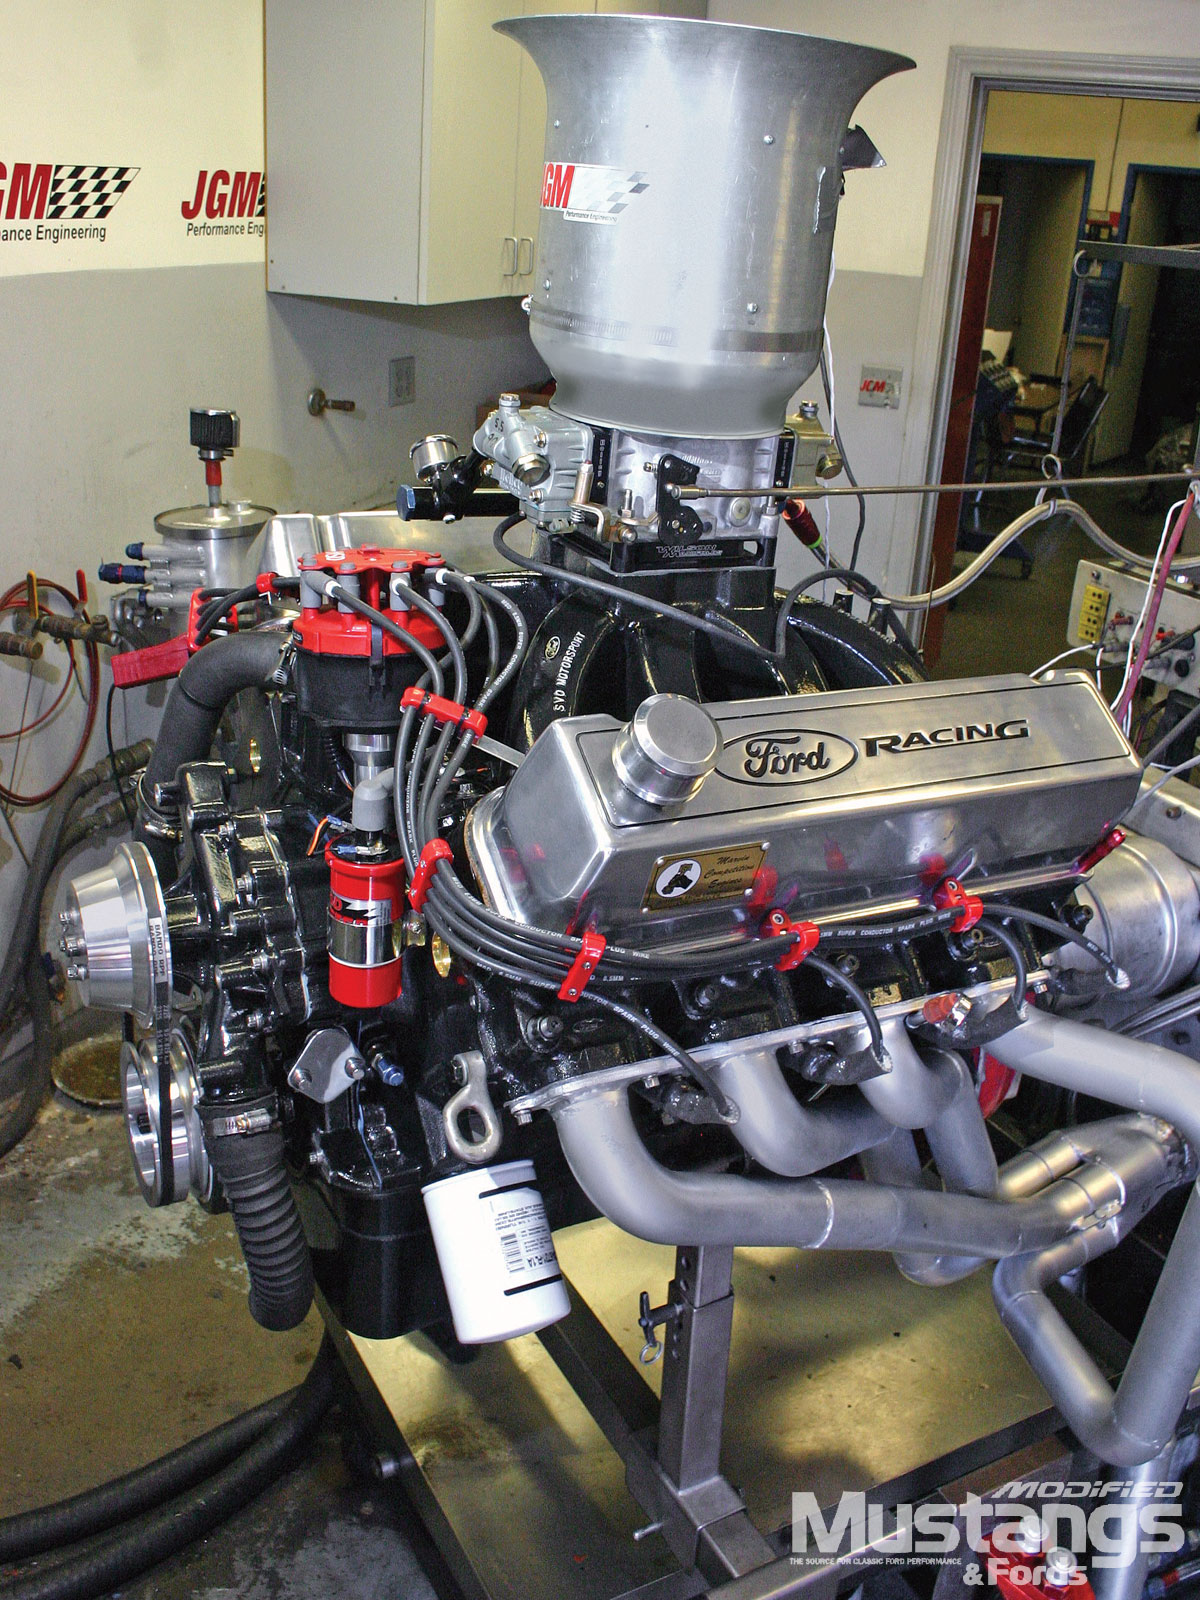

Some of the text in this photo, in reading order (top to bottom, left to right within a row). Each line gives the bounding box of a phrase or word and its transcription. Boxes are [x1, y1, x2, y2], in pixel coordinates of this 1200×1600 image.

[181, 170, 261, 219] JGM
[541, 163, 575, 209] GM
[36, 224, 107, 244] Engineering
[187, 221, 264, 238] Performance Eng
[493, 653, 518, 686] CONDUCTOR
[553, 631, 586, 712] SVO MOTORSPORT
[744, 719, 1029, 778] Ford RACING
[154, 924, 164, 955] BANDO
[514, 920, 563, 938] CONDUCTOR
[860, 928, 893, 937] CONDUCTOR
[528, 979, 556, 991] SUPER
[613, 1006, 637, 1023] SPARK
